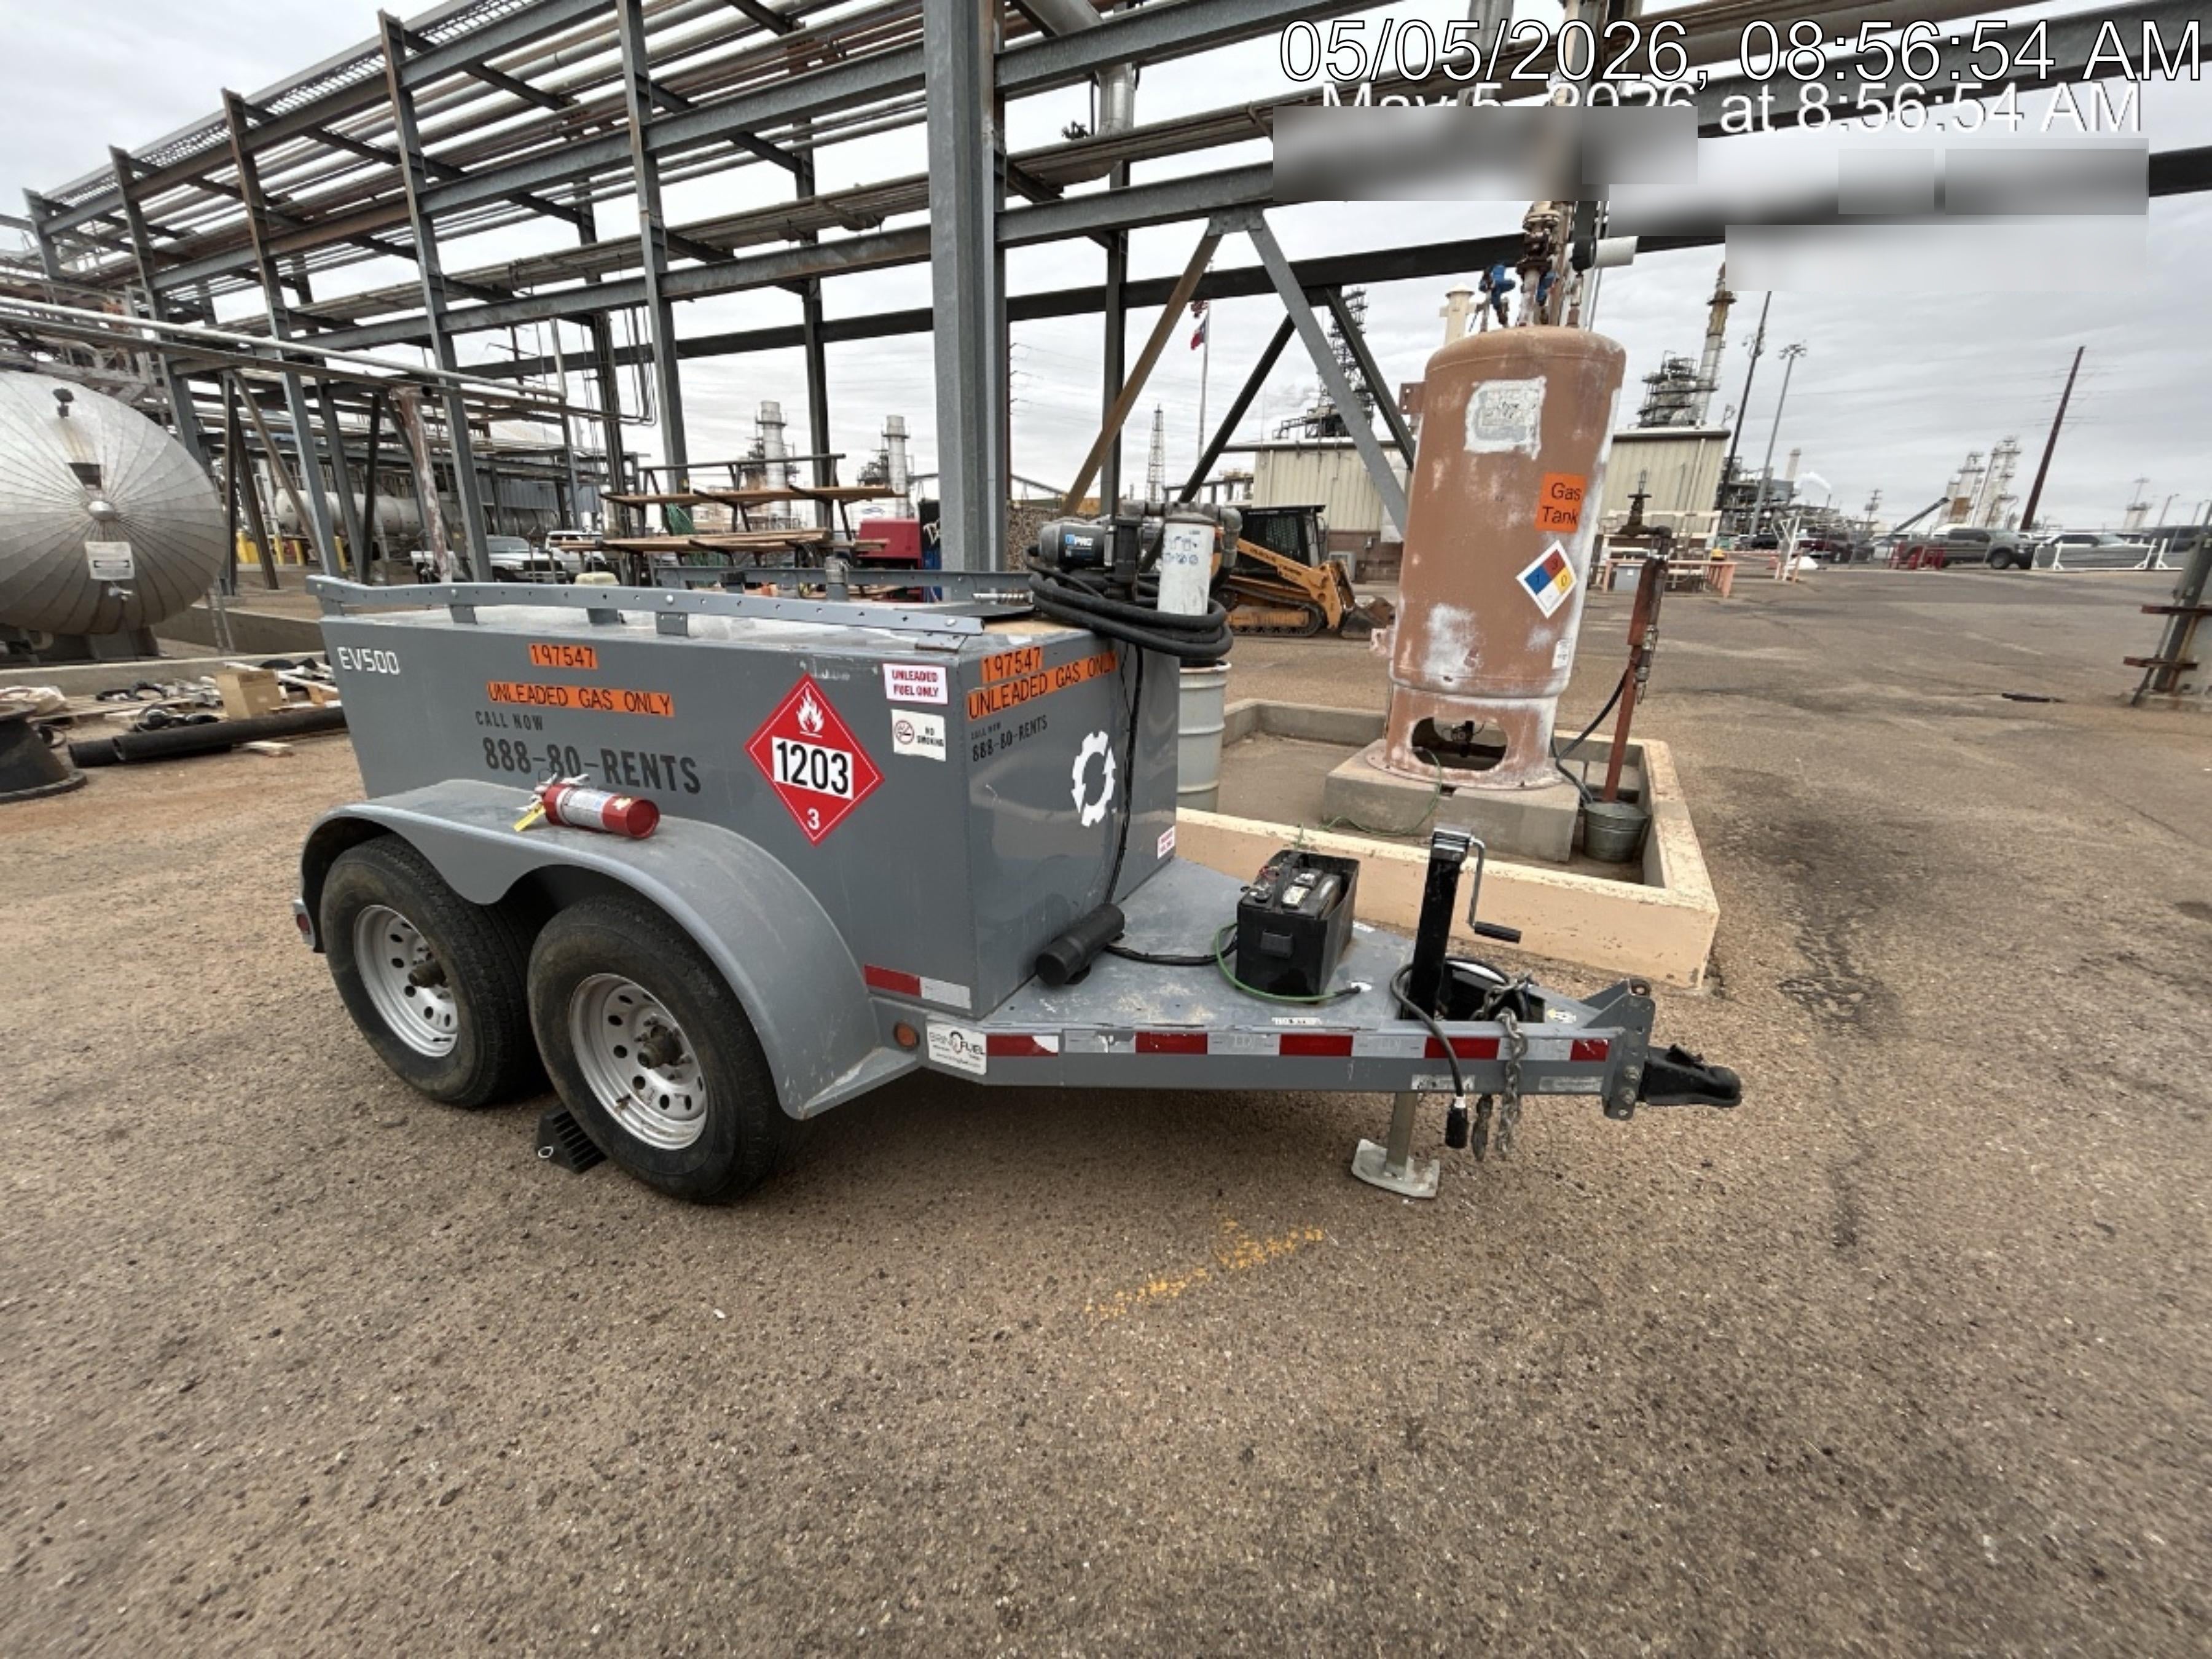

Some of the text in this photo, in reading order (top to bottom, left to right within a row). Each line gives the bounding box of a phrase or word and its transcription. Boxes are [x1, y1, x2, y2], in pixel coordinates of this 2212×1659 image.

[1551, 482, 1582, 501] Gas
[1543, 506, 1577, 524] Tank
[1551, 558, 1558, 570] 3
[1561, 575, 1567, 587] 0
[337, 646, 401, 675] EV500
[531, 645, 594, 668] 197547
[984, 647, 1041, 681] 197547
[892, 669, 938, 683] UNLEADED
[488, 683, 670, 715] UNLEADED GAS ONLY
[893, 684, 939, 697] FUEL ONLY
[969, 673, 1048, 719] UNLEADED
[1056, 662, 1081, 688] GAS
[476, 710, 543, 731] CALL NOW
[973, 715, 1047, 761] 888-80-RENTS
[482, 737, 701, 794] 888-80-RENTS
[776, 740, 849, 794] 1203
[807, 808, 820, 830] 3
